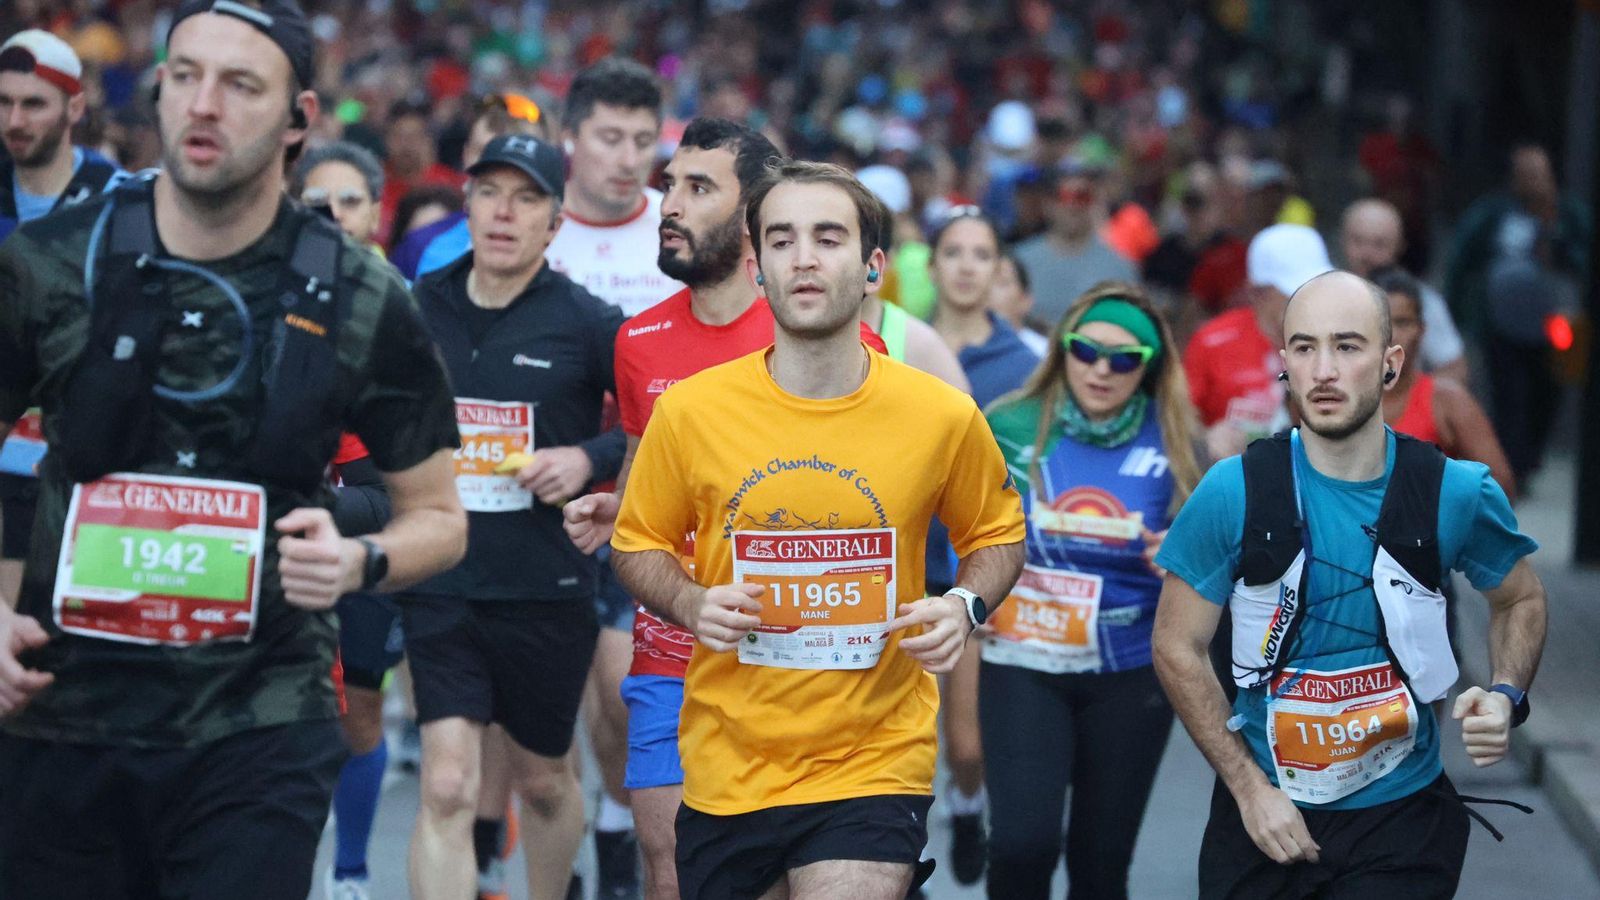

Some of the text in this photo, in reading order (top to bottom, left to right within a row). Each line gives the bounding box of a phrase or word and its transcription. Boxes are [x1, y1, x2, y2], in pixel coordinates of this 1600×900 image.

[628, 322, 661, 336] luanvi
[456, 407, 521, 425] ENERALI
[767, 455, 837, 475] Chamber
[838, 468, 858, 481] of
[124, 483, 249, 518] GENERALI
[119, 536, 207, 575] 1942
[777, 537, 882, 559] GENERALI
[769, 581, 861, 607] 11965
[800, 610, 831, 619] MANE
[1264, 585, 1296, 666] SALOMON
[847, 635, 873, 645] 21K
[1304, 670, 1392, 700] GENERALI
[1295, 714, 1383, 746] 11964
[1328, 746, 1356, 758] JUAN
